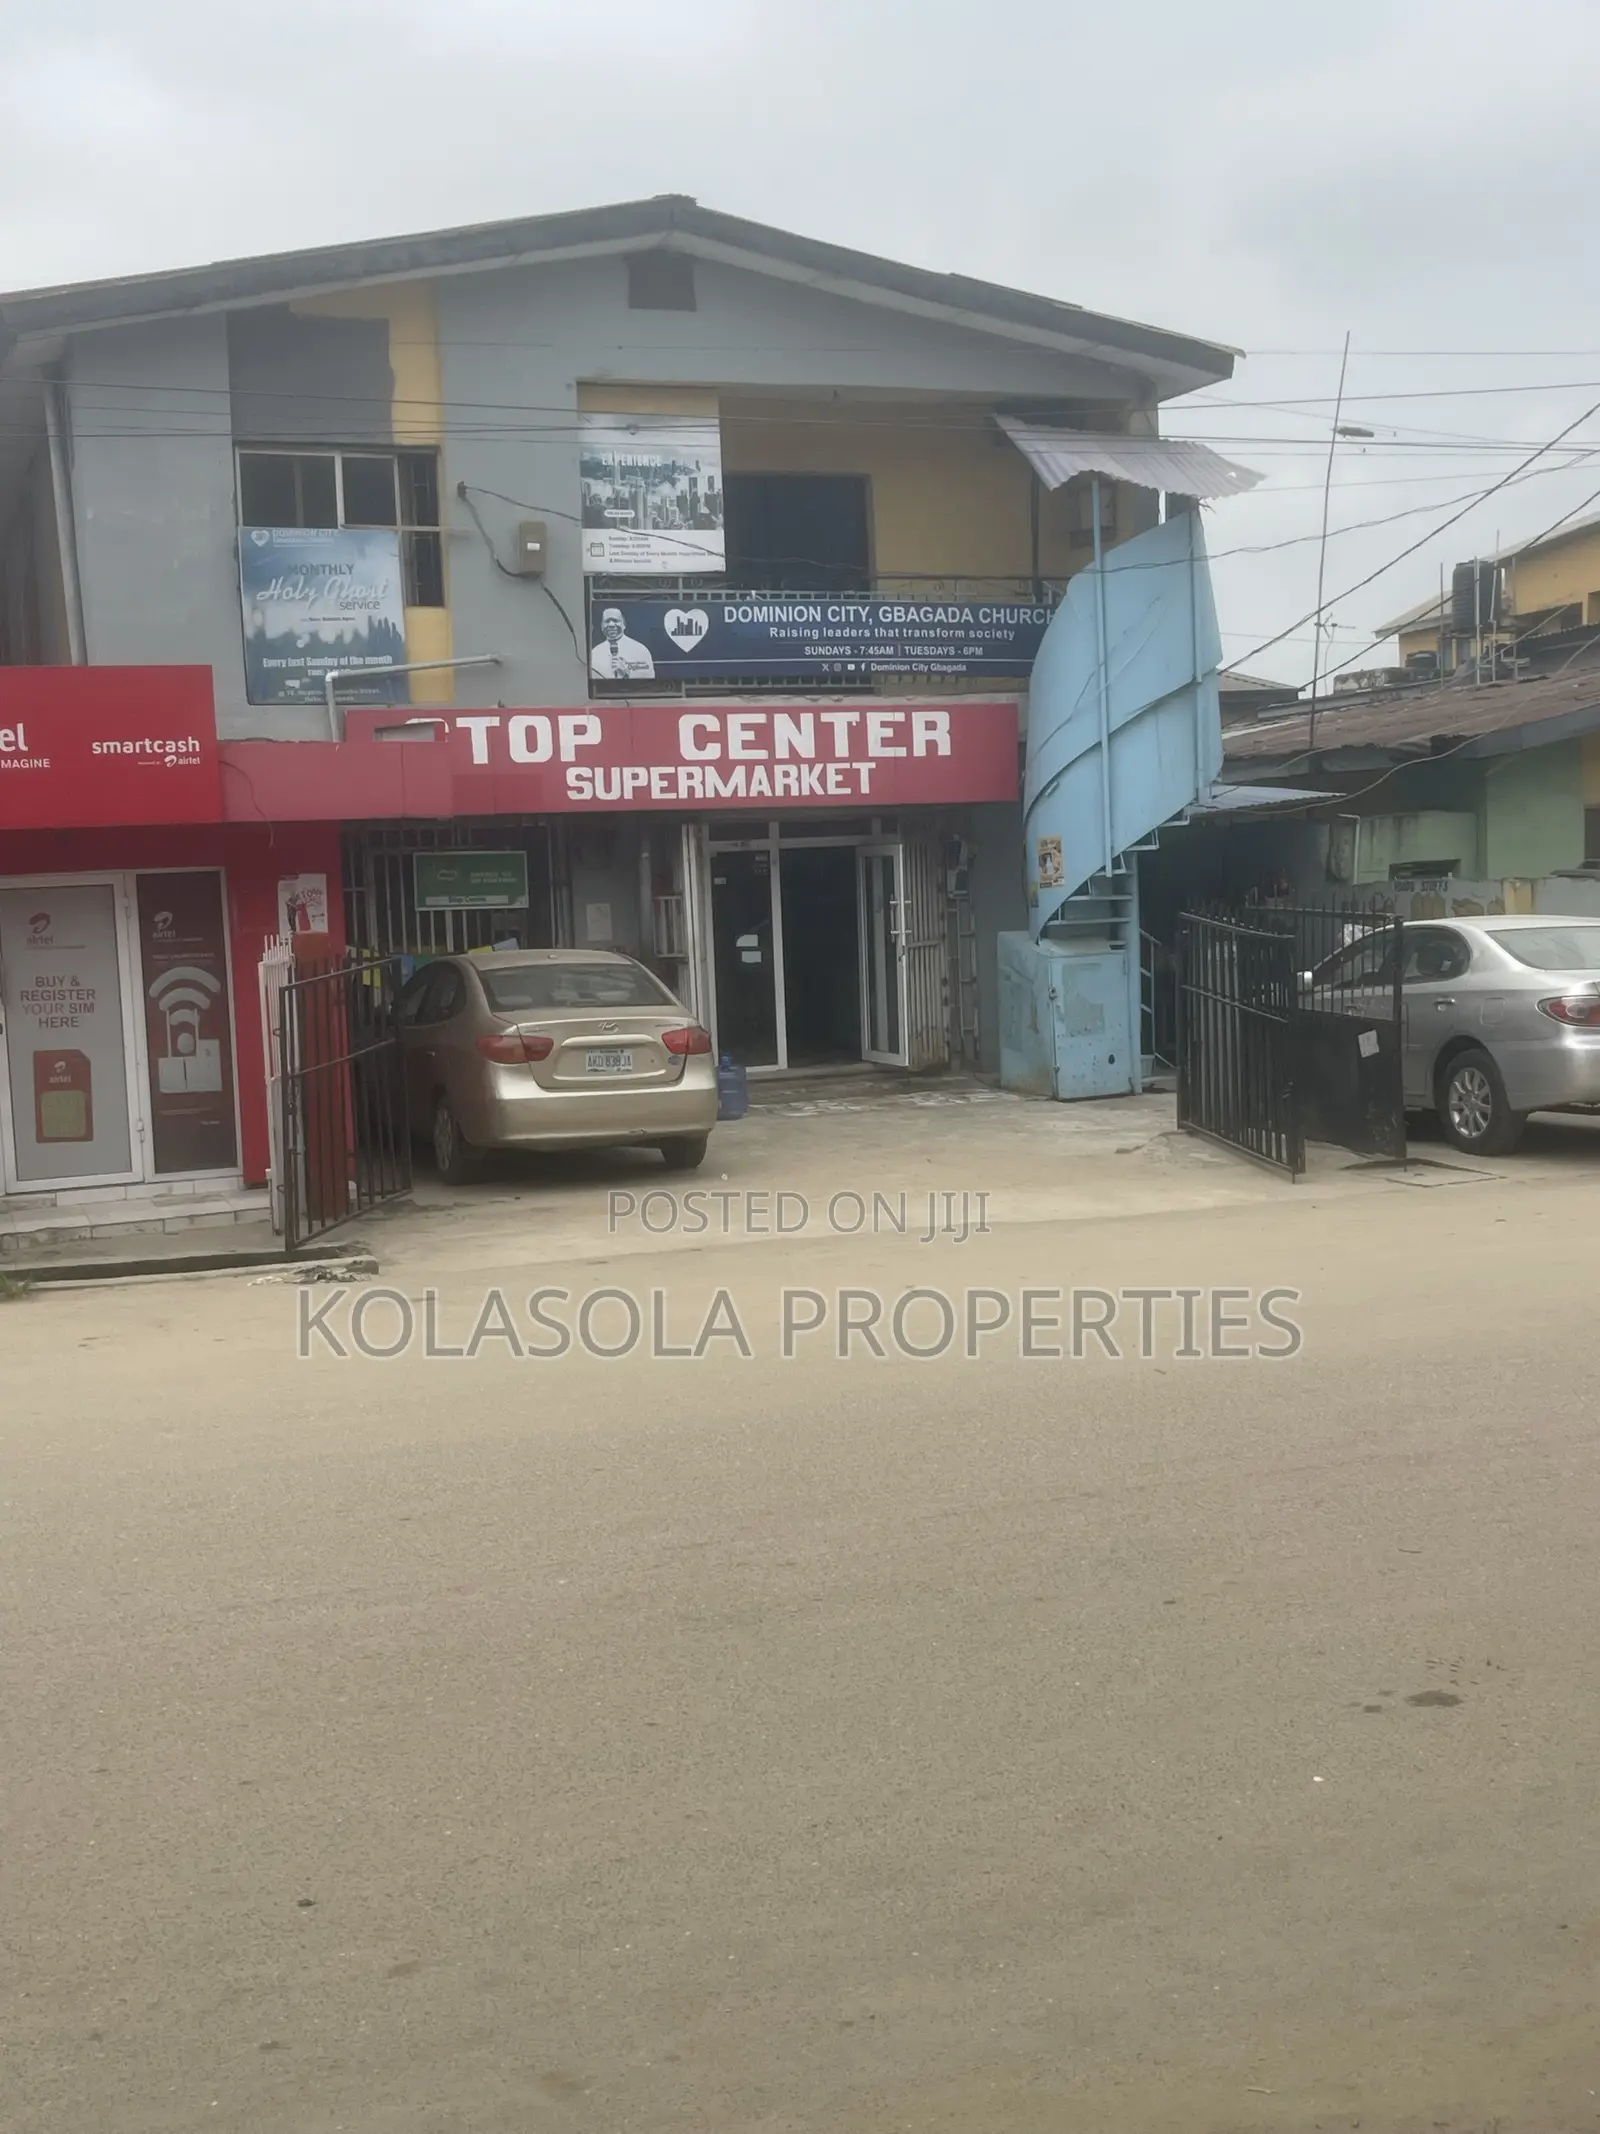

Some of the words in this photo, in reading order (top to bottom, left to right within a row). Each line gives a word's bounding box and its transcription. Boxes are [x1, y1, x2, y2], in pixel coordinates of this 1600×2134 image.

[602, 454, 662, 466] EXPERIENCE
[288, 564, 354, 576] MONTHLY
[256, 576, 317, 610] Holy
[324, 576, 389, 601] Ghost
[340, 601, 380, 611] service
[724, 606, 821, 623] DOMINION
[827, 606, 873, 625] CITY,
[878, 606, 974, 624] GBAGADA
[770, 627, 819, 640] Raising
[823, 627, 870, 638] leaders
[874, 627, 899, 638] that
[903, 627, 965, 638] transform
[969, 628, 1015, 641] society
[804, 646, 851, 656] SUNDAYS
[860, 646, 894, 656] 7:45AM
[904, 646, 955, 656] TUESDAYS
[963, 647, 983, 656] 6PM
[263, 657, 286, 668] Every
[307, 656, 339, 668] Sunday
[349, 656, 364, 666] the
[365, 655, 392, 665] month
[871, 662, 911, 672] Dominion
[912, 662, 929, 673] City
[404, 714, 602, 765] TOP
[678, 711, 951, 761] CENTER
[92, 736, 200, 754] smartcash
[178, 756, 200, 765] airtel
[566, 762, 876, 800] SUPERMARKET
[35, 975, 67, 987] BUY
[70, 975, 81, 987] &
[20, 989, 96, 1002] REGISTER
[22, 1003, 64, 1015] YOUR
[69, 1002, 95, 1014] SIM
[38, 1016, 79, 1029] HERE
